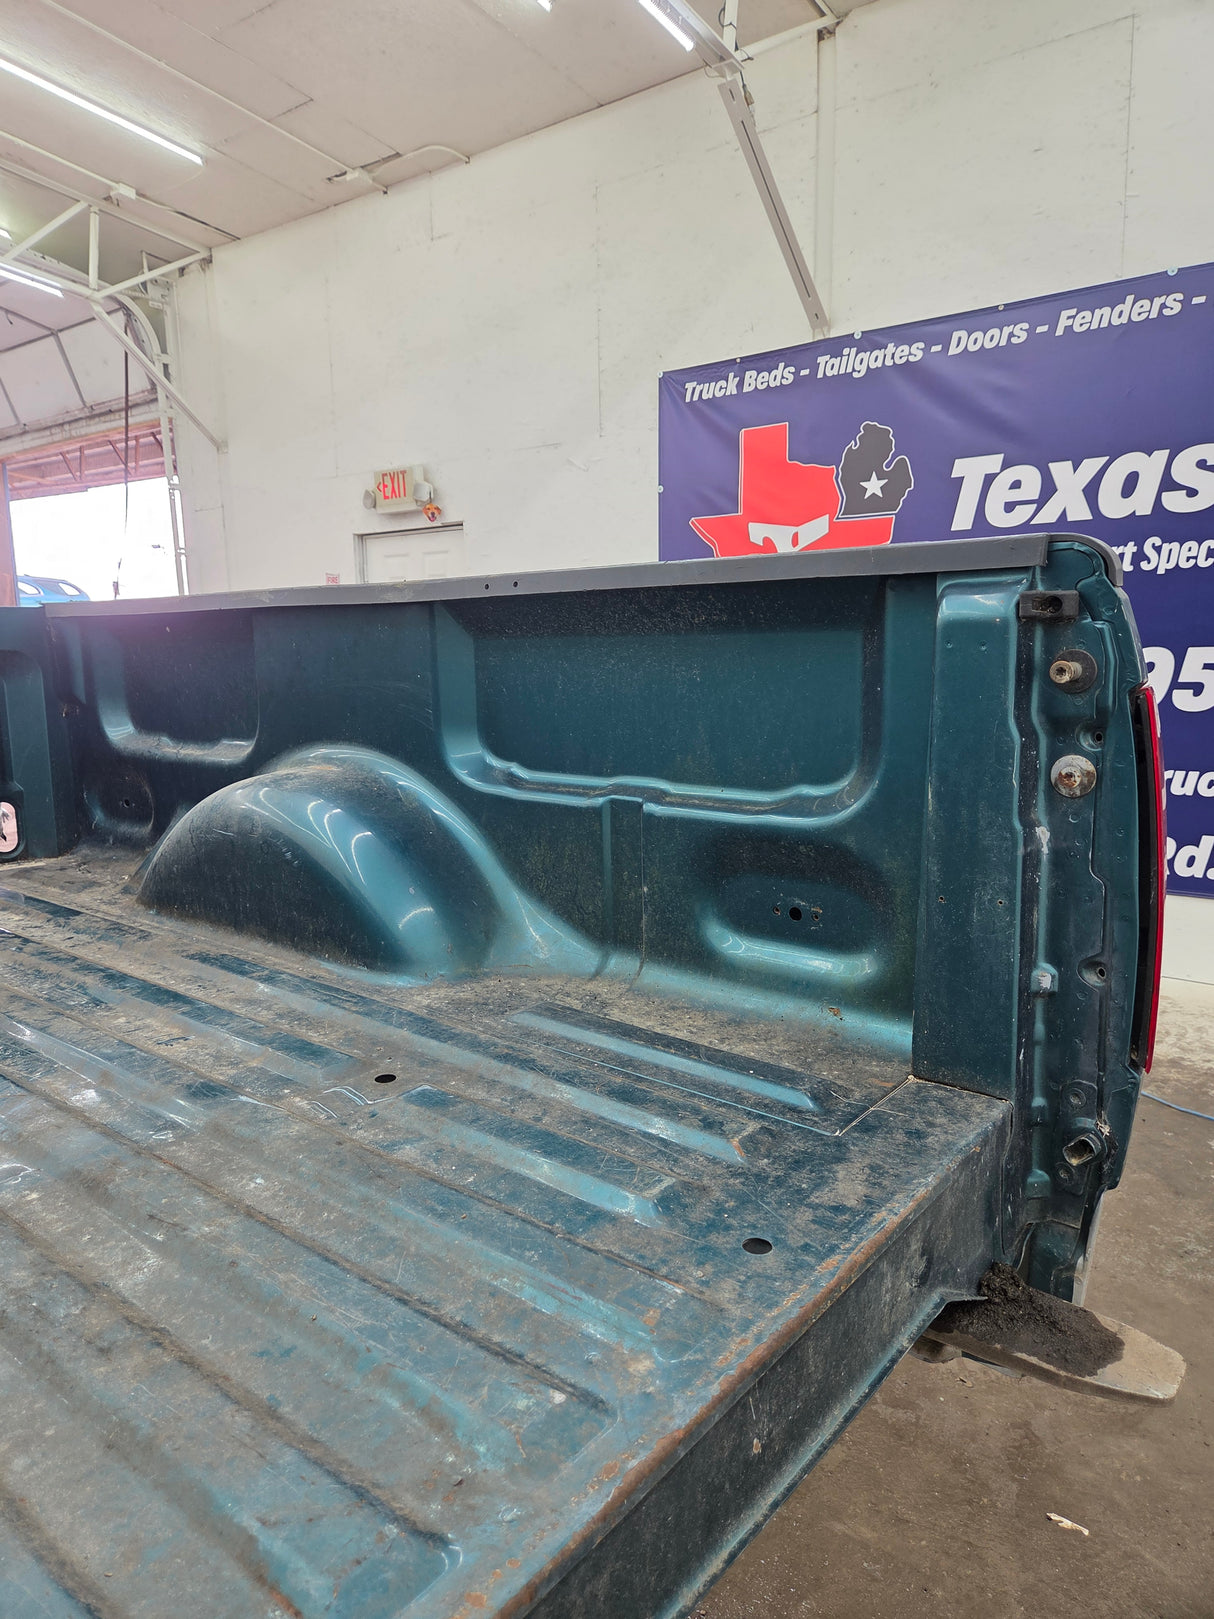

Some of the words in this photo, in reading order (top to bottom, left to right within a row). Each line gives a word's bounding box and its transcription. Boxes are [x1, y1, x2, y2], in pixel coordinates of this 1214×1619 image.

[684, 372, 739, 403] Truck
[743, 362, 796, 393] Beds
[816, 341, 926, 379] Tailgates
[947, 322, 1030, 357] Doors
[1054, 292, 1184, 337] Fenders
[381, 470, 407, 500] EXIT
[950, 442, 1214, 532] Texas
[1139, 536, 1214, 575] Spec
